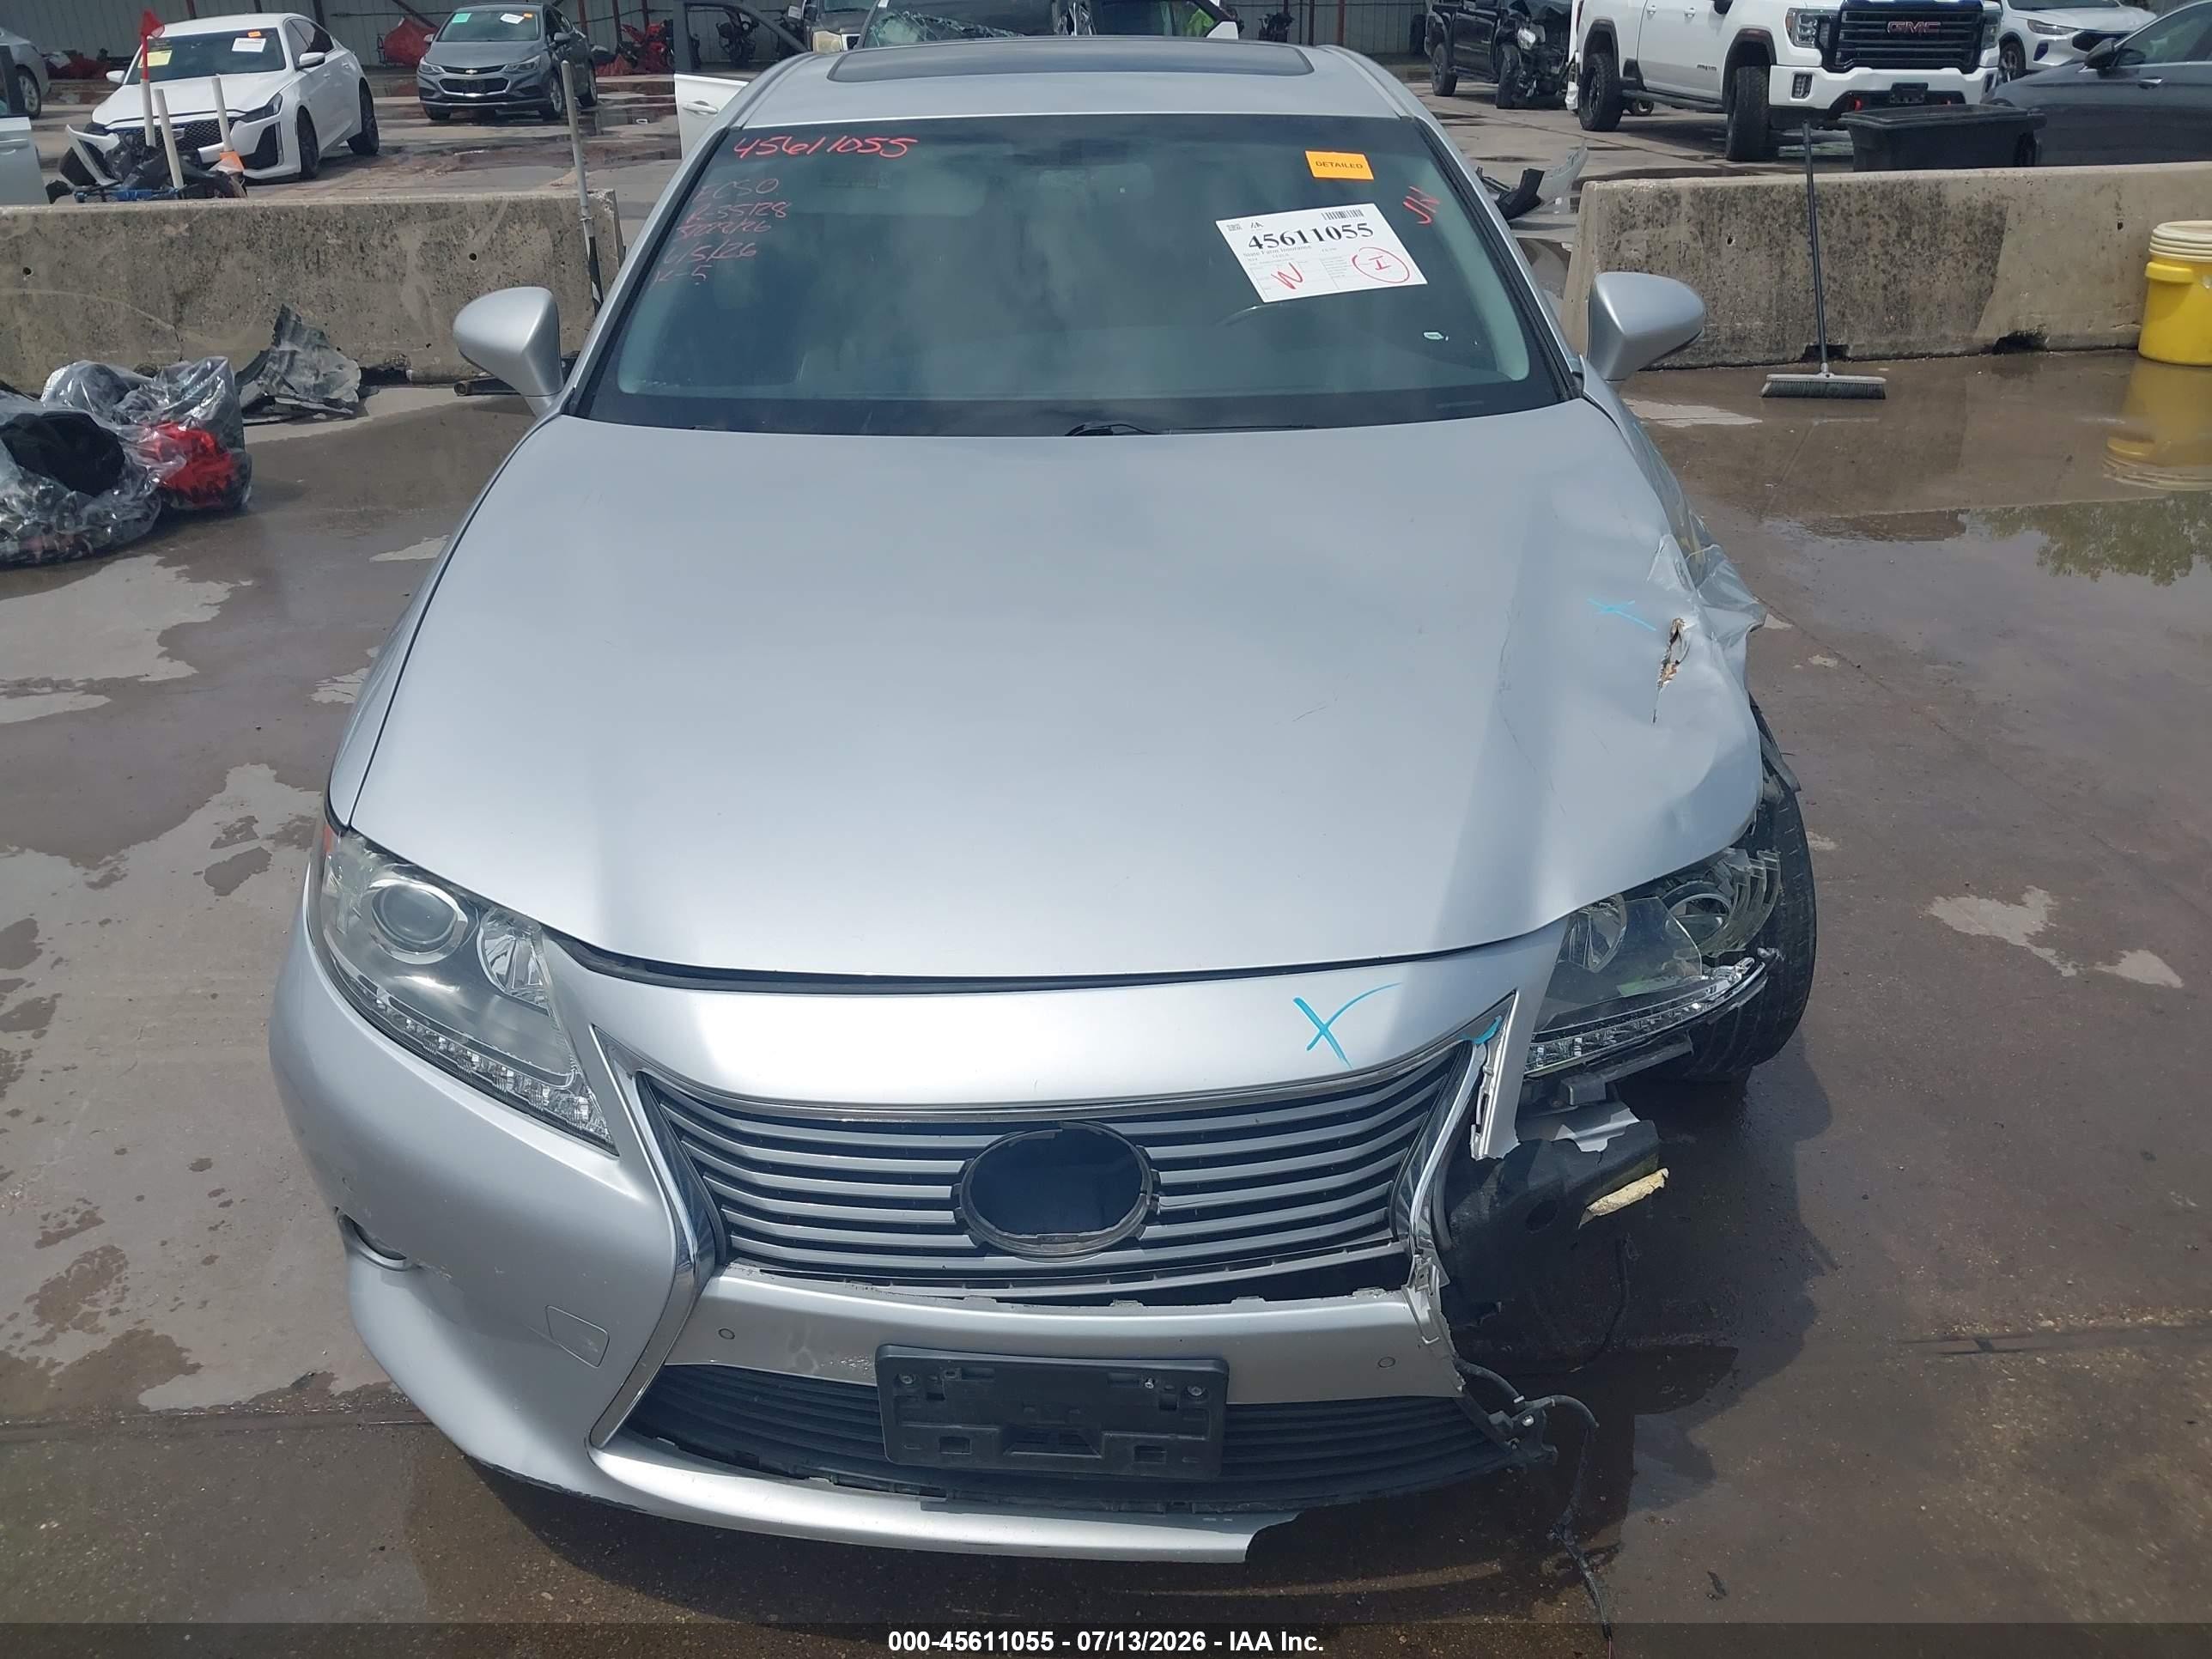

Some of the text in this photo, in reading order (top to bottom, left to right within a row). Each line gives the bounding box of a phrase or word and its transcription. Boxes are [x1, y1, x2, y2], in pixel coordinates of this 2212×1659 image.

[1887, 21, 1941, 33] GMC
[733, 136, 919, 160] 45611055
[1315, 161, 1364, 169] DETAILED
[1248, 222, 1374, 250] 45611055
